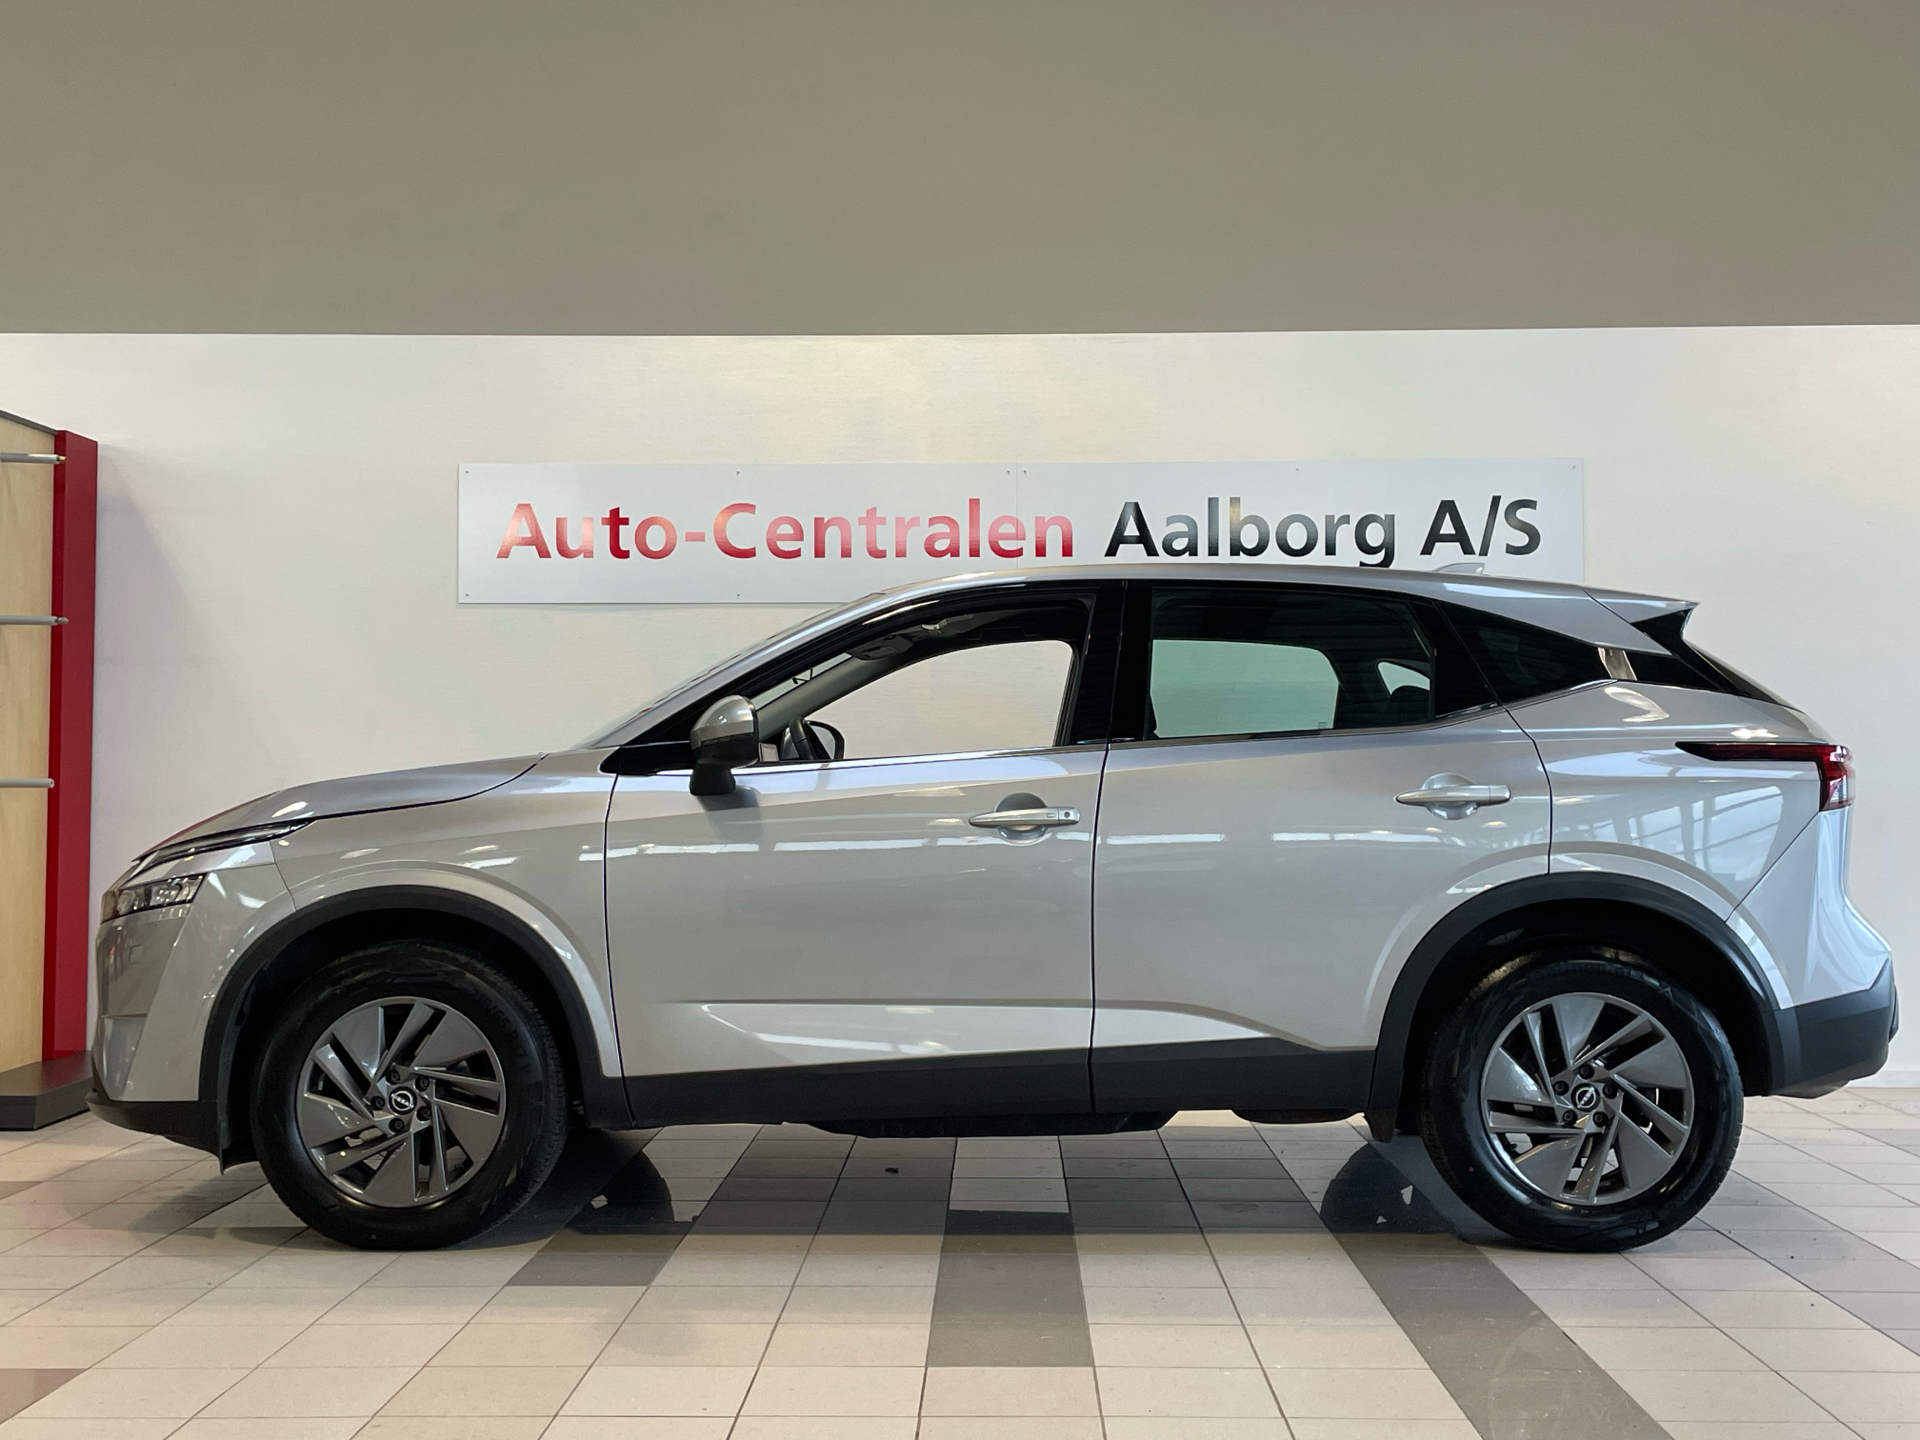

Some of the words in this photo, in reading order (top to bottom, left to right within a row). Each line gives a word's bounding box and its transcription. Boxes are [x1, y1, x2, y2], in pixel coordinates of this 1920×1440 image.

[497, 498, 1073, 559] Auto-Centralen
[1104, 497, 1395, 567] Aalborg
[1420, 495, 1541, 556] A/S
